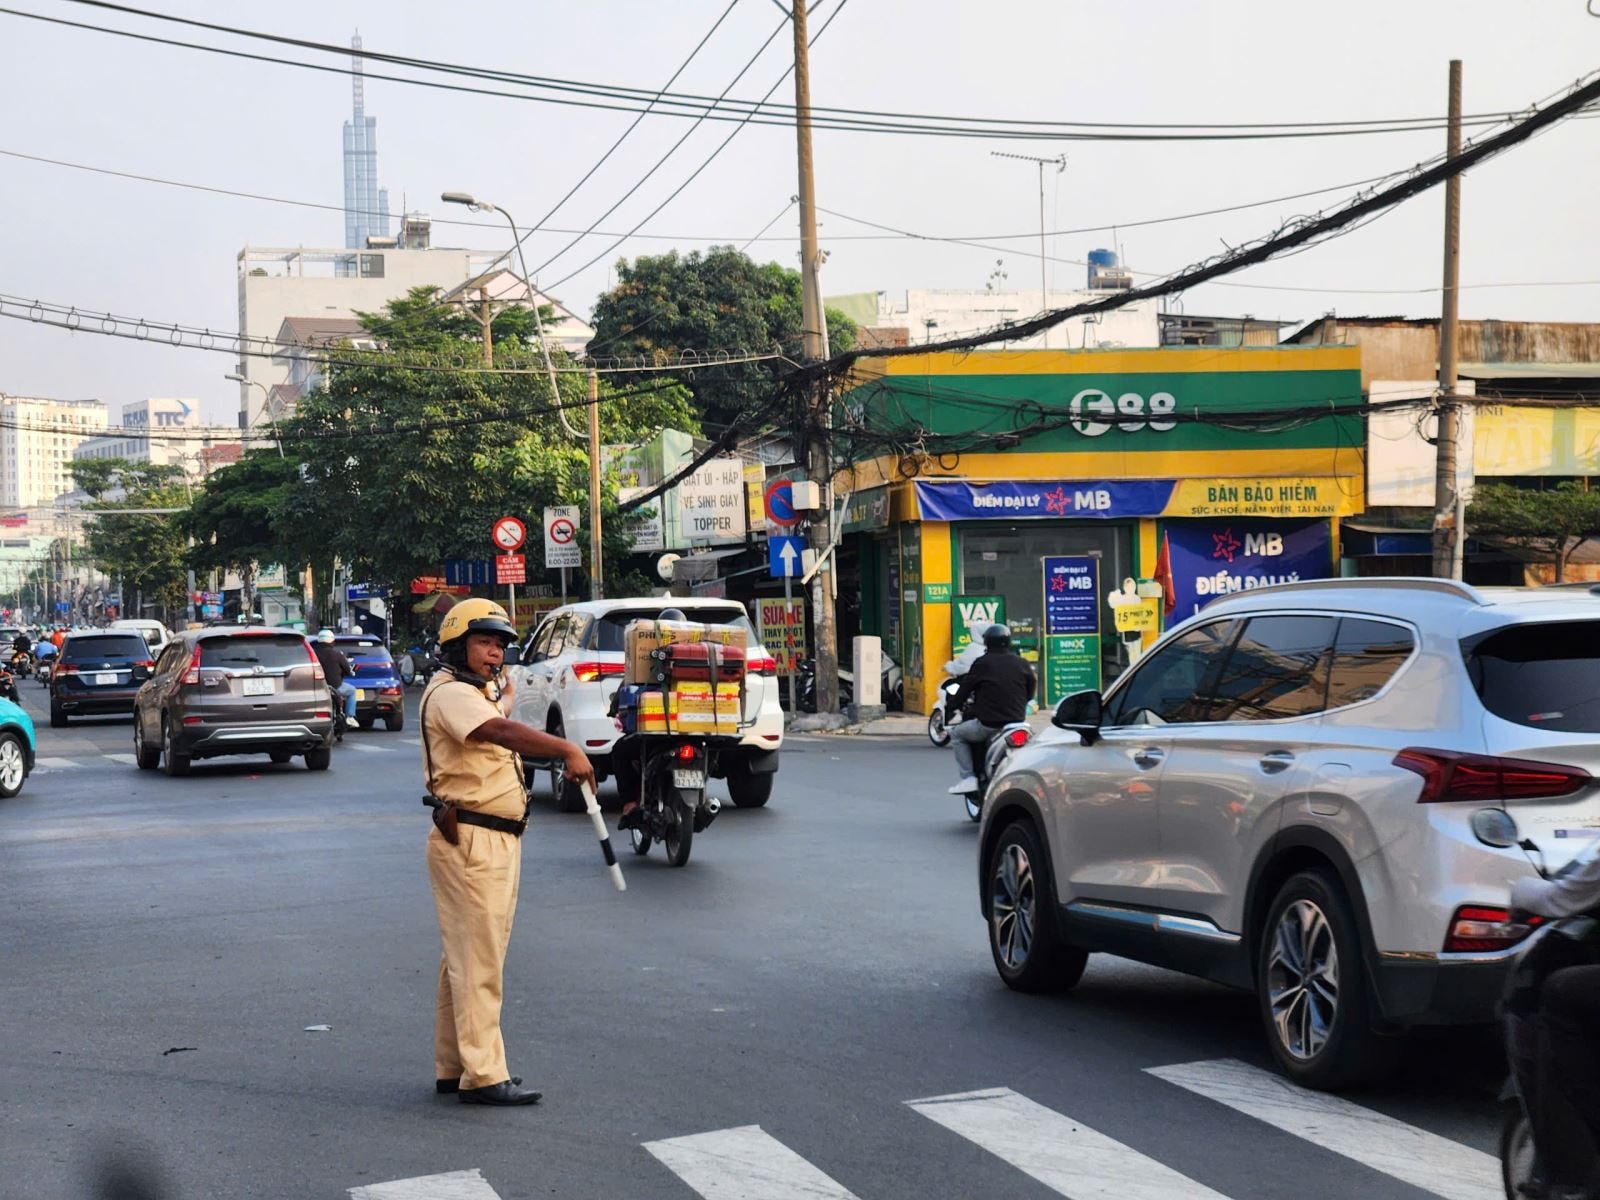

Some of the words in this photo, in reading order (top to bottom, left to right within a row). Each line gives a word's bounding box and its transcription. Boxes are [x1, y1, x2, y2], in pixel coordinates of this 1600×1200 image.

[154, 411, 186, 427] TTC
[1068, 388, 1177, 437] F88
[1208, 484, 1238, 502] BÁN
[1244, 481, 1273, 502] BẢO
[697, 495, 717, 509] SINH
[1004, 496, 1025, 510] ĐẠI
[1026, 493, 1040, 508] LÝ
[1074, 490, 1112, 511] MB
[553, 508, 571, 516] ZONE
[693, 516, 731, 532] TOPPER
[1244, 533, 1283, 556] MB
[1069, 576, 1092, 590] MB
[928, 586, 948, 596] 121A
[958, 602, 999, 620] VAY
[1118, 611, 1128, 623] 15
[639, 631, 677, 640] PHIS
[764, 628, 782, 638] THAY
